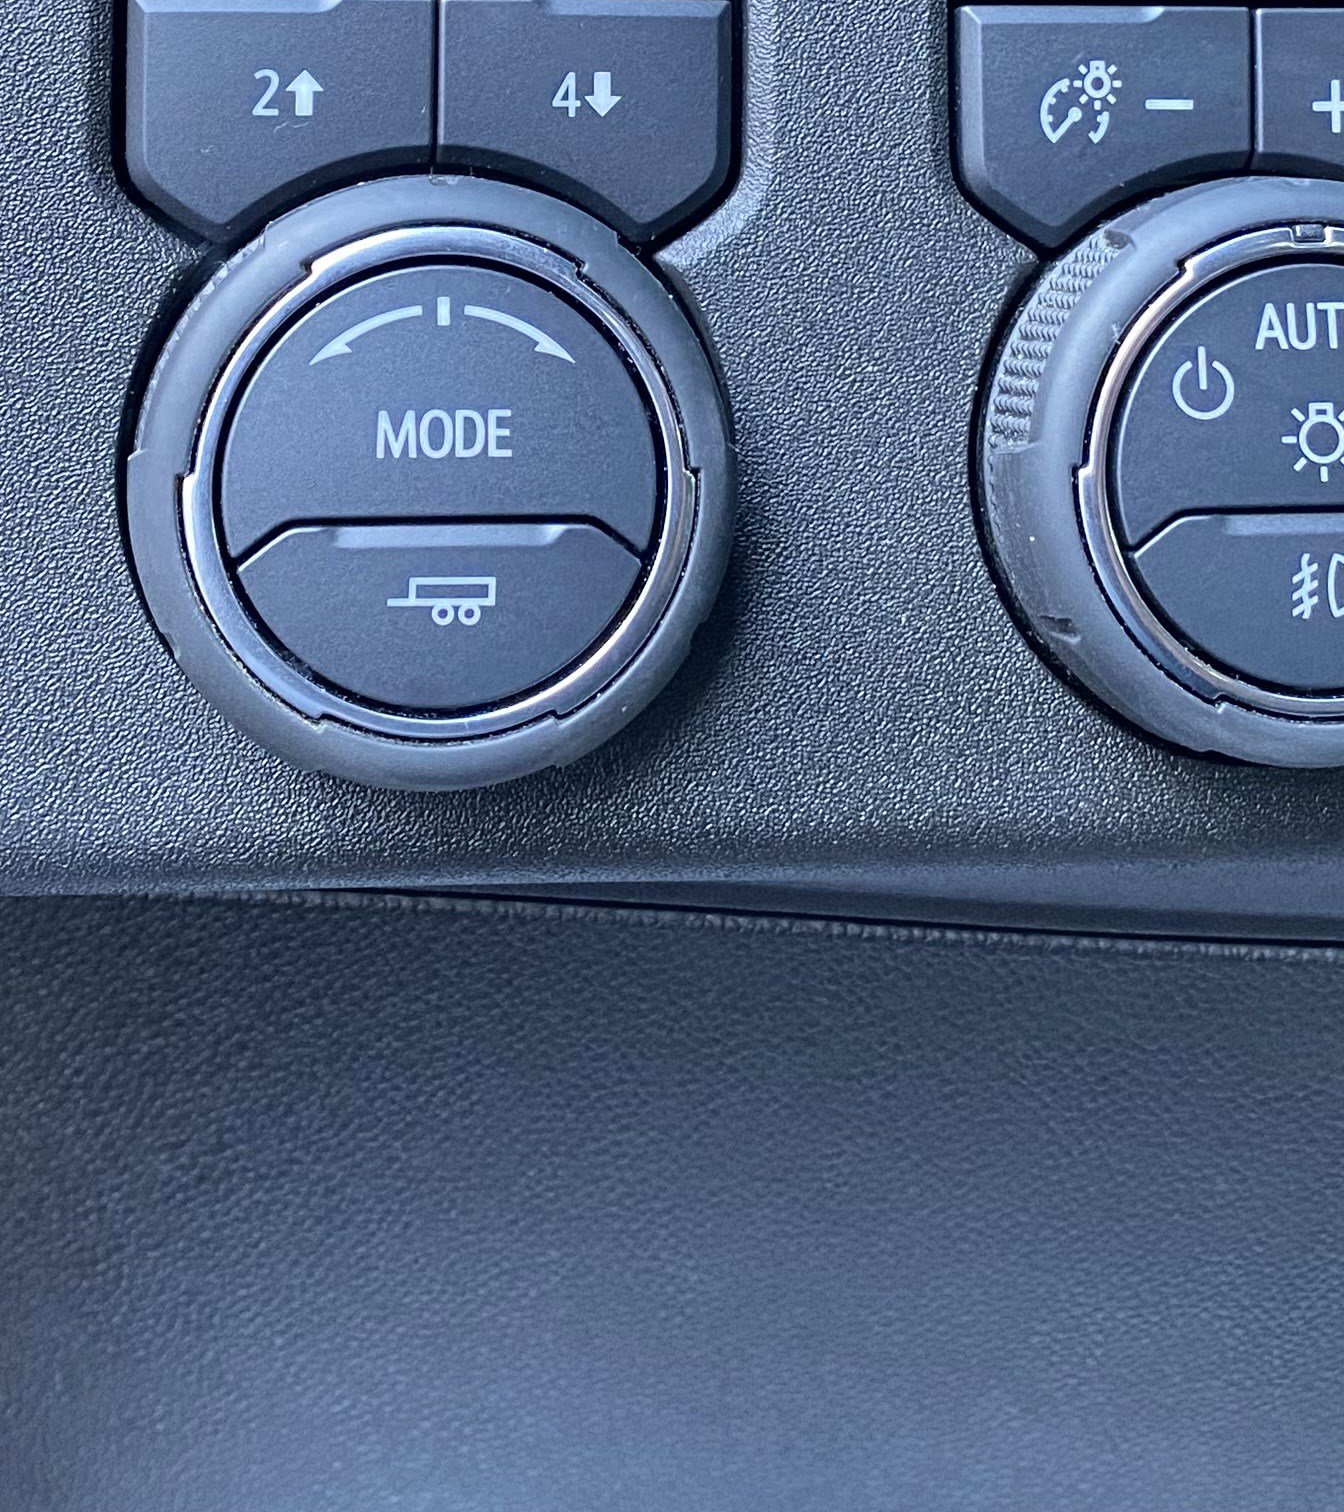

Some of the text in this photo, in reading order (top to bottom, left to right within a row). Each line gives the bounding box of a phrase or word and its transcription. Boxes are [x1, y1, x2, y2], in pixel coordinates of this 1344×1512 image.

[252, 68, 281, 117] 2
[551, 71, 581, 118] 4
[376, 409, 513, 459] MODE
